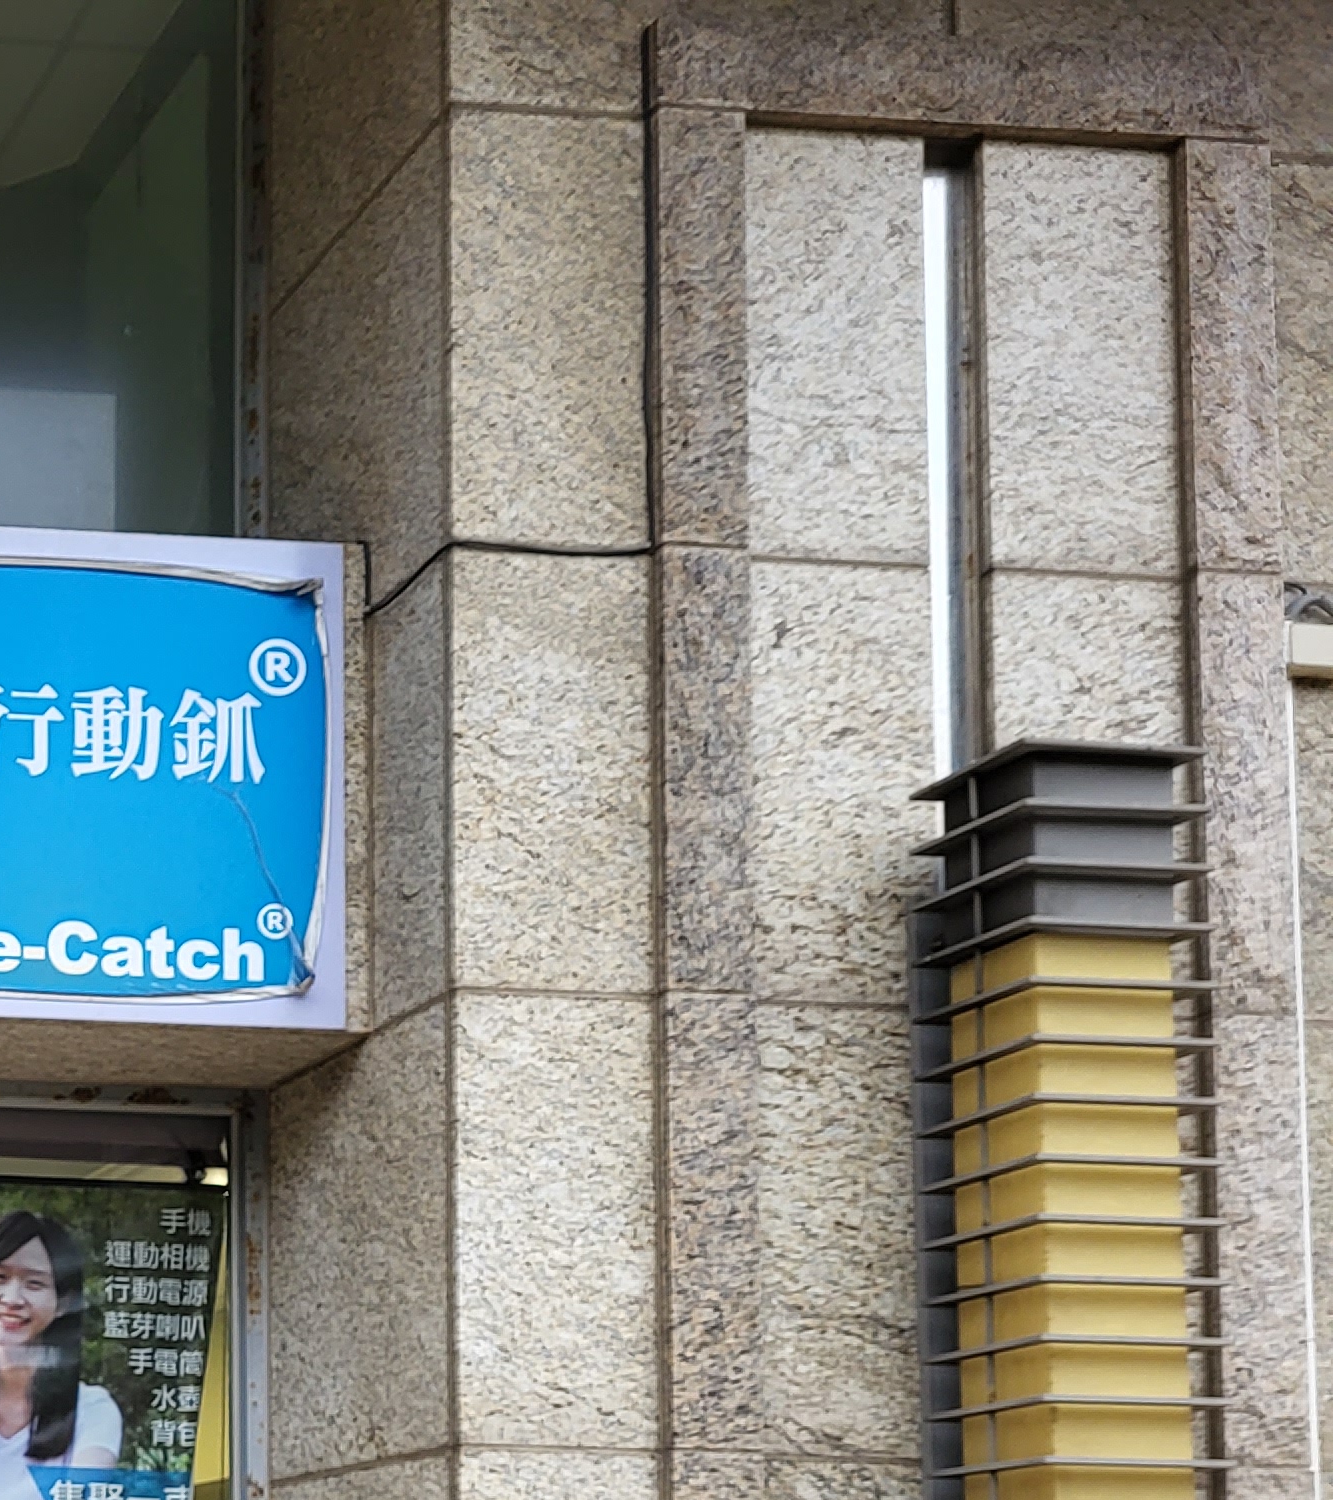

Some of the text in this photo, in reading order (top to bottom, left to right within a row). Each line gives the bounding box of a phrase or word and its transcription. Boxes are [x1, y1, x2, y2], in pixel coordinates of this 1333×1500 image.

[159, 1207, 212, 1237] 手機
[104, 1239, 211, 1272] 運動相機
[104, 1275, 209, 1307] 行動電源
[102, 1310, 206, 1341] 藍芽喇叭
[128, 1348, 204, 1378] 手電筒
[151, 1384, 201, 1413] 水壺
